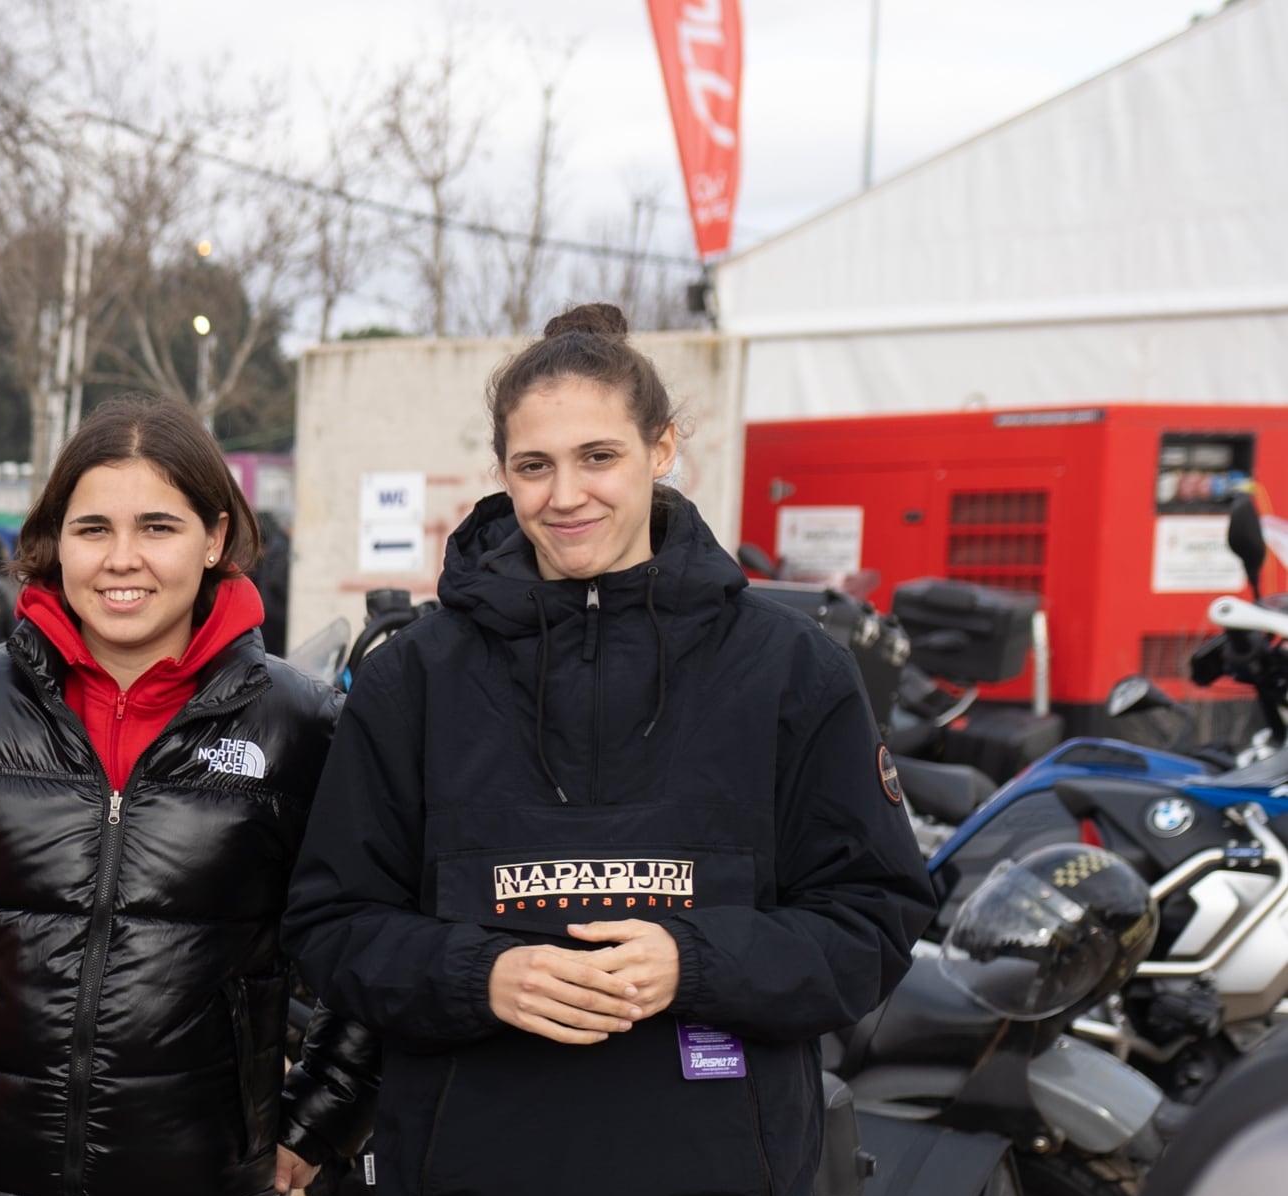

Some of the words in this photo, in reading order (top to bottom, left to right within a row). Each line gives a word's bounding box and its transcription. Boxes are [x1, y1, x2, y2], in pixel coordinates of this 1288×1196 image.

[220, 738, 246, 752] THE
[198, 748, 243, 763] NORTH
[208, 760, 242, 774] FACE
[498, 862, 691, 896] NAPAPIJRI
[495, 896, 693, 914] geographic
